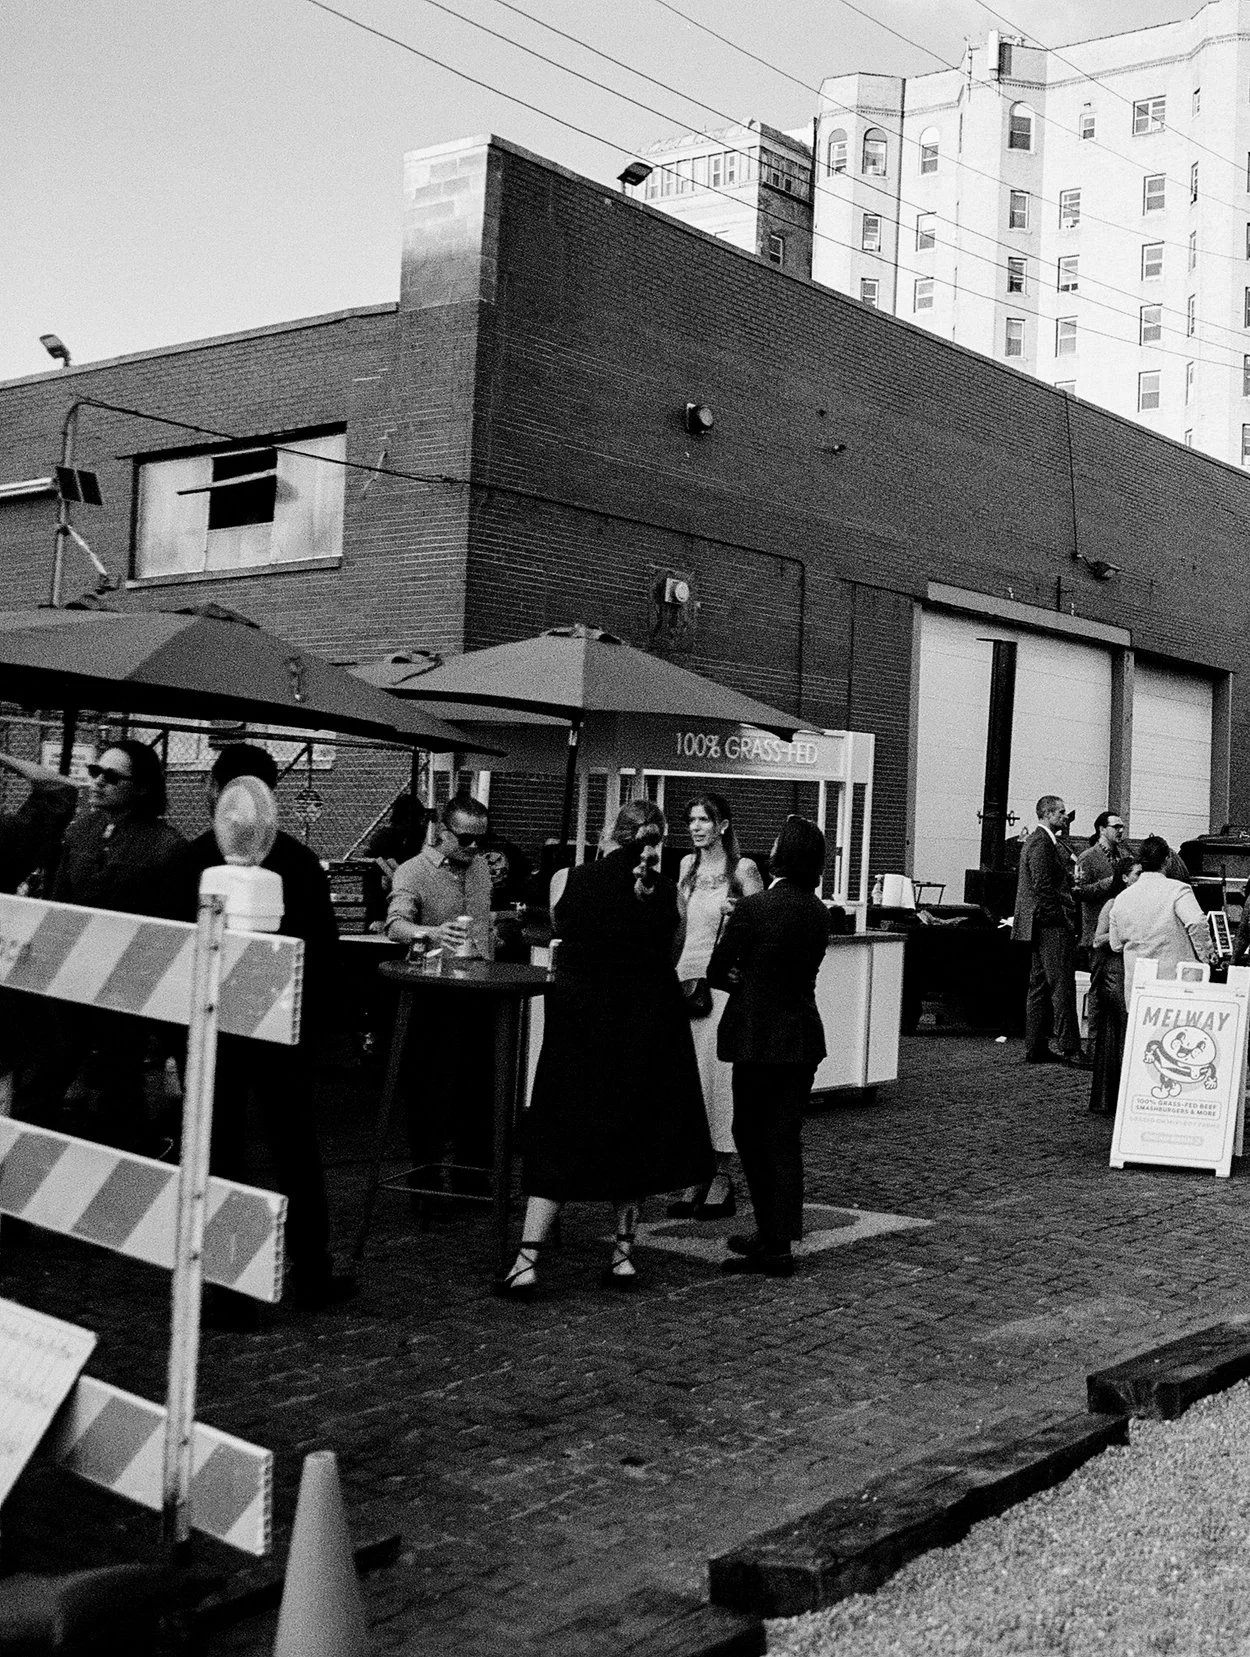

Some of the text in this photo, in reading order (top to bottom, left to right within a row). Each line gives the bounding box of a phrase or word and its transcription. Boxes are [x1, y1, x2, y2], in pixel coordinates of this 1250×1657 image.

[677, 732, 817, 764] 100% GRASS-FED
[1142, 1006, 1230, 1032] MELWAY
[1135, 1105, 1189, 1115] SMASHBURGERS
[1136, 1098, 1156, 1106] 100%
[1158, 1100, 1198, 1109] GRASS-FED
